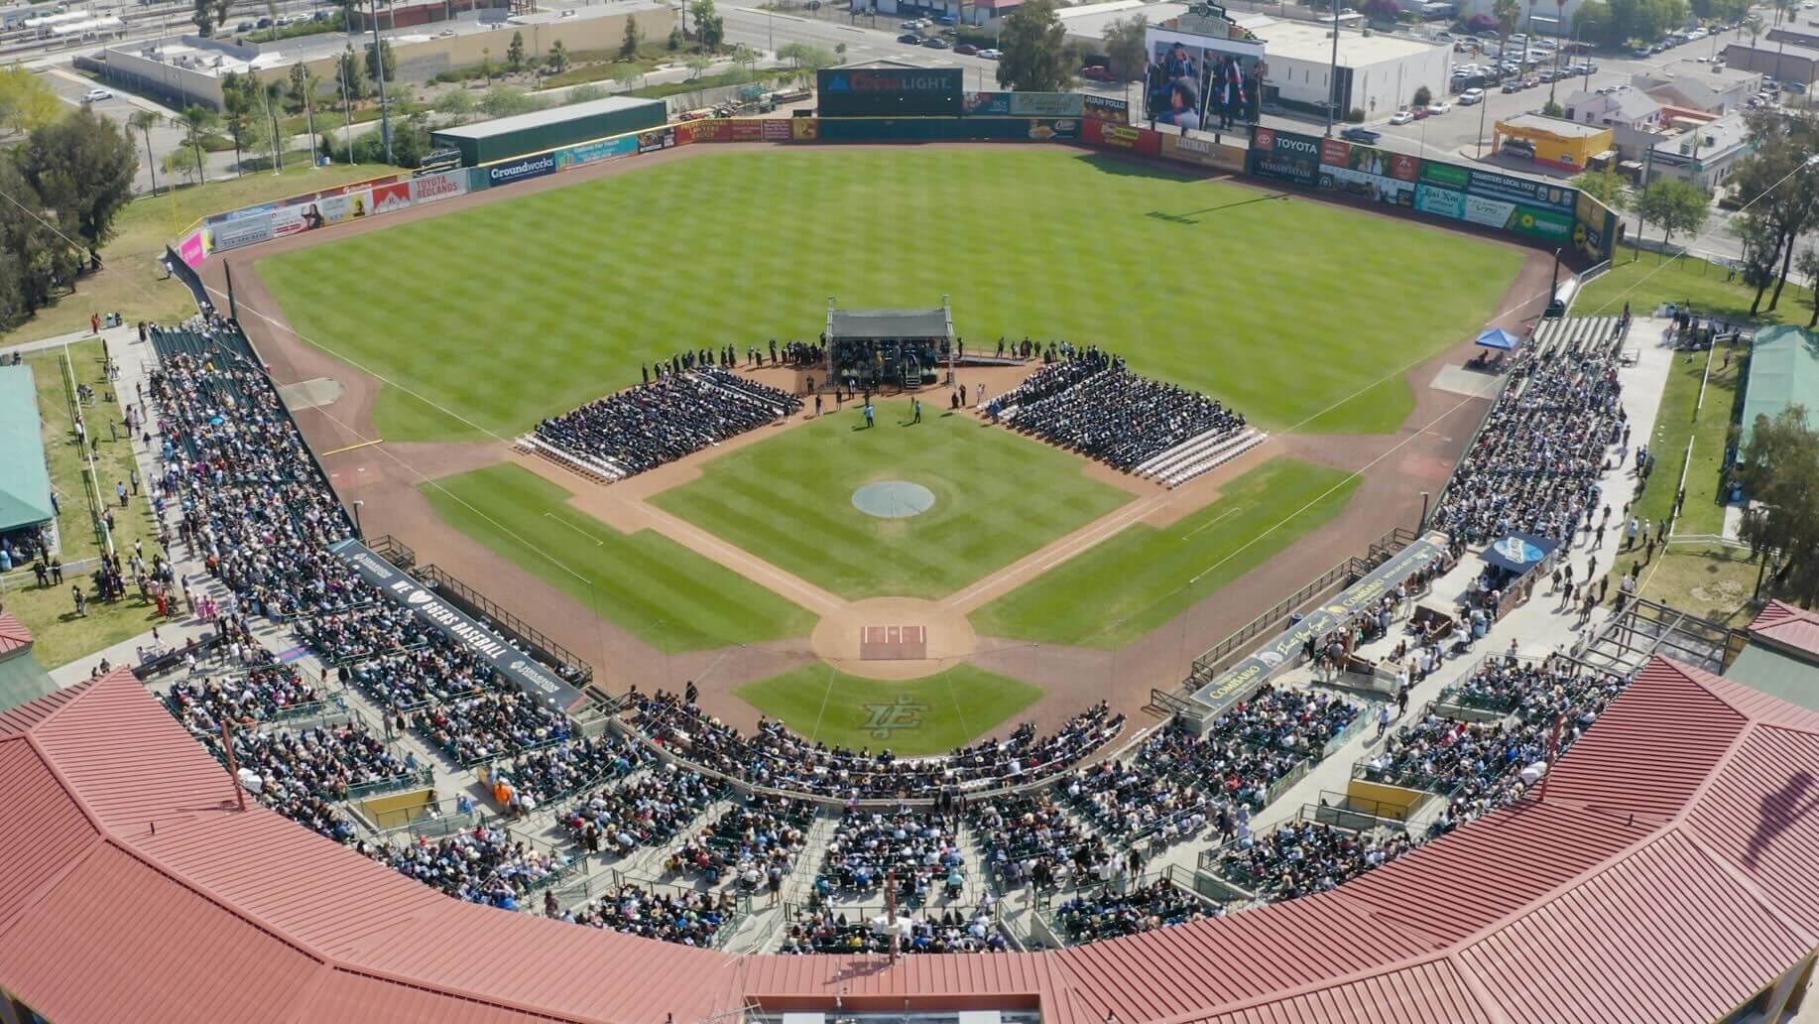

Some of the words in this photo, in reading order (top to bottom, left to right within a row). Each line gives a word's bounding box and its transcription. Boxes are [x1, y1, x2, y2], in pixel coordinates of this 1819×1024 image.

[902, 76, 947, 90] LIGHT
[1086, 96, 1104, 106] JUAN
[1105, 99, 1126, 109] POLLO
[1276, 137, 1318, 155] TOYOTA
[491, 158, 554, 179] Groundworks
[391, 580, 413, 594] WE
[450, 621, 507, 659] BASEBALL
